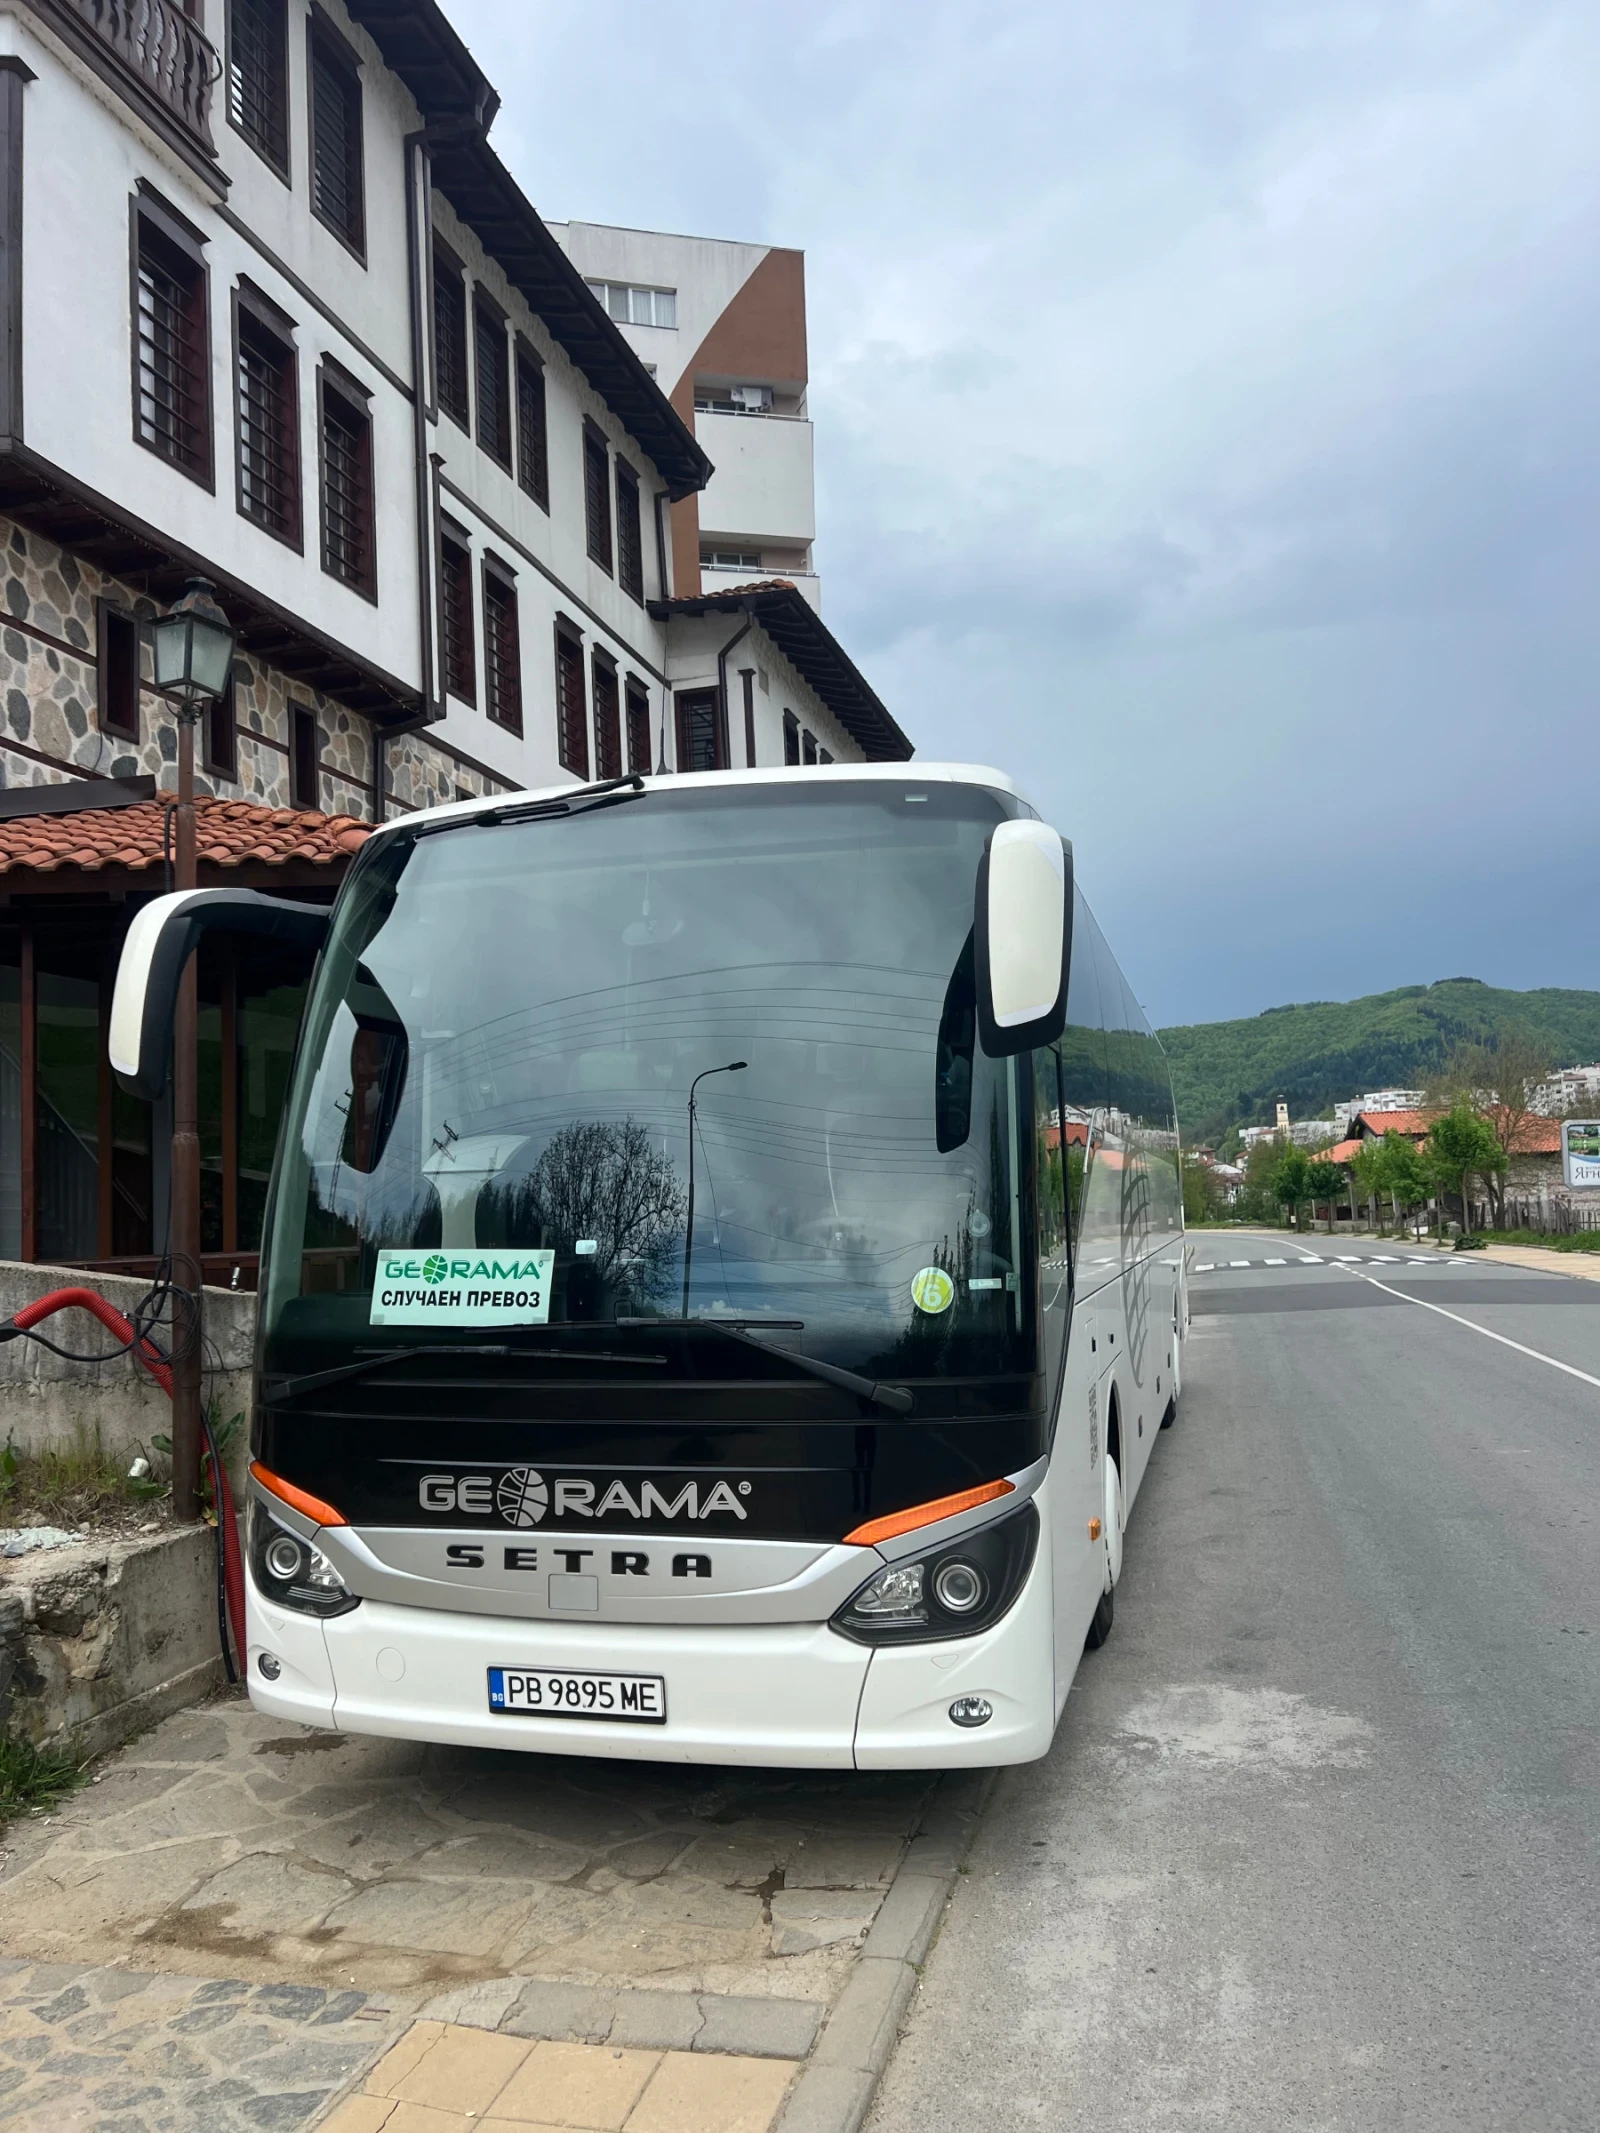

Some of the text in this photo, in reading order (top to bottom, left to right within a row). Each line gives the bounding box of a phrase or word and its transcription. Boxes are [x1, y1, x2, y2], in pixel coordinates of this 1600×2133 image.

[381, 1289, 541, 1308] СЛУЧАЕН ПРЕВОЗ
[923, 1283, 942, 1307] 6
[446, 1544, 713, 1578] SETRA
[508, 1676, 658, 1712] PB 9895 ME
